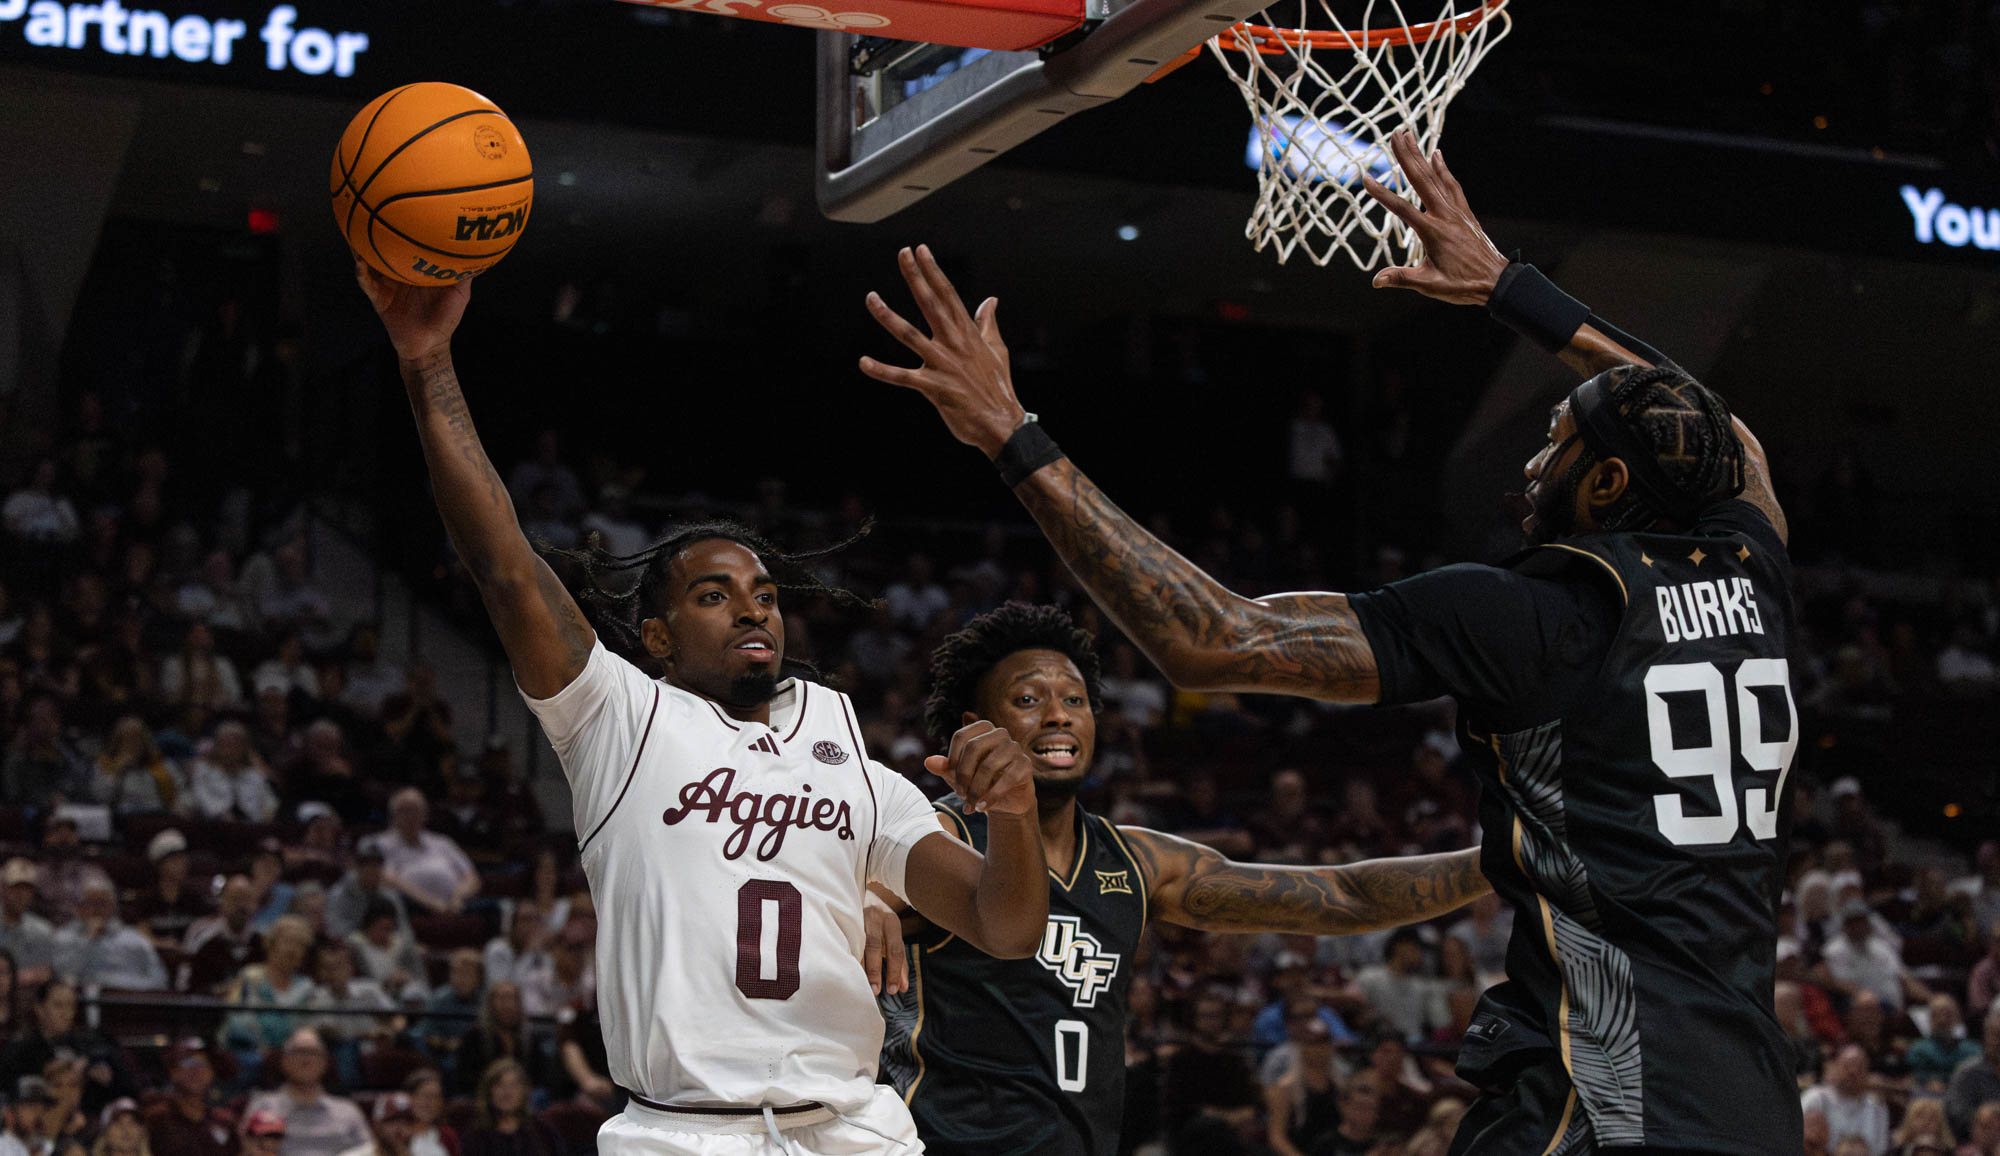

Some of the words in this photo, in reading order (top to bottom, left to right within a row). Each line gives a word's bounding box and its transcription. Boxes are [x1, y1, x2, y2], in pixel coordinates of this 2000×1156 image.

[260, 4, 369, 78] for
[455, 203, 528, 241] NCAA
[1900, 184, 2000, 251] You
[1655, 577, 1764, 643] BURKS
[814, 741, 841, 759] SEC
[1643, 658, 1799, 846] 99
[662, 767, 855, 861] Aggies
[736, 878, 802, 1000] 0
[1037, 915, 1120, 1008] UCF
[1055, 1019, 1088, 1092] 0
